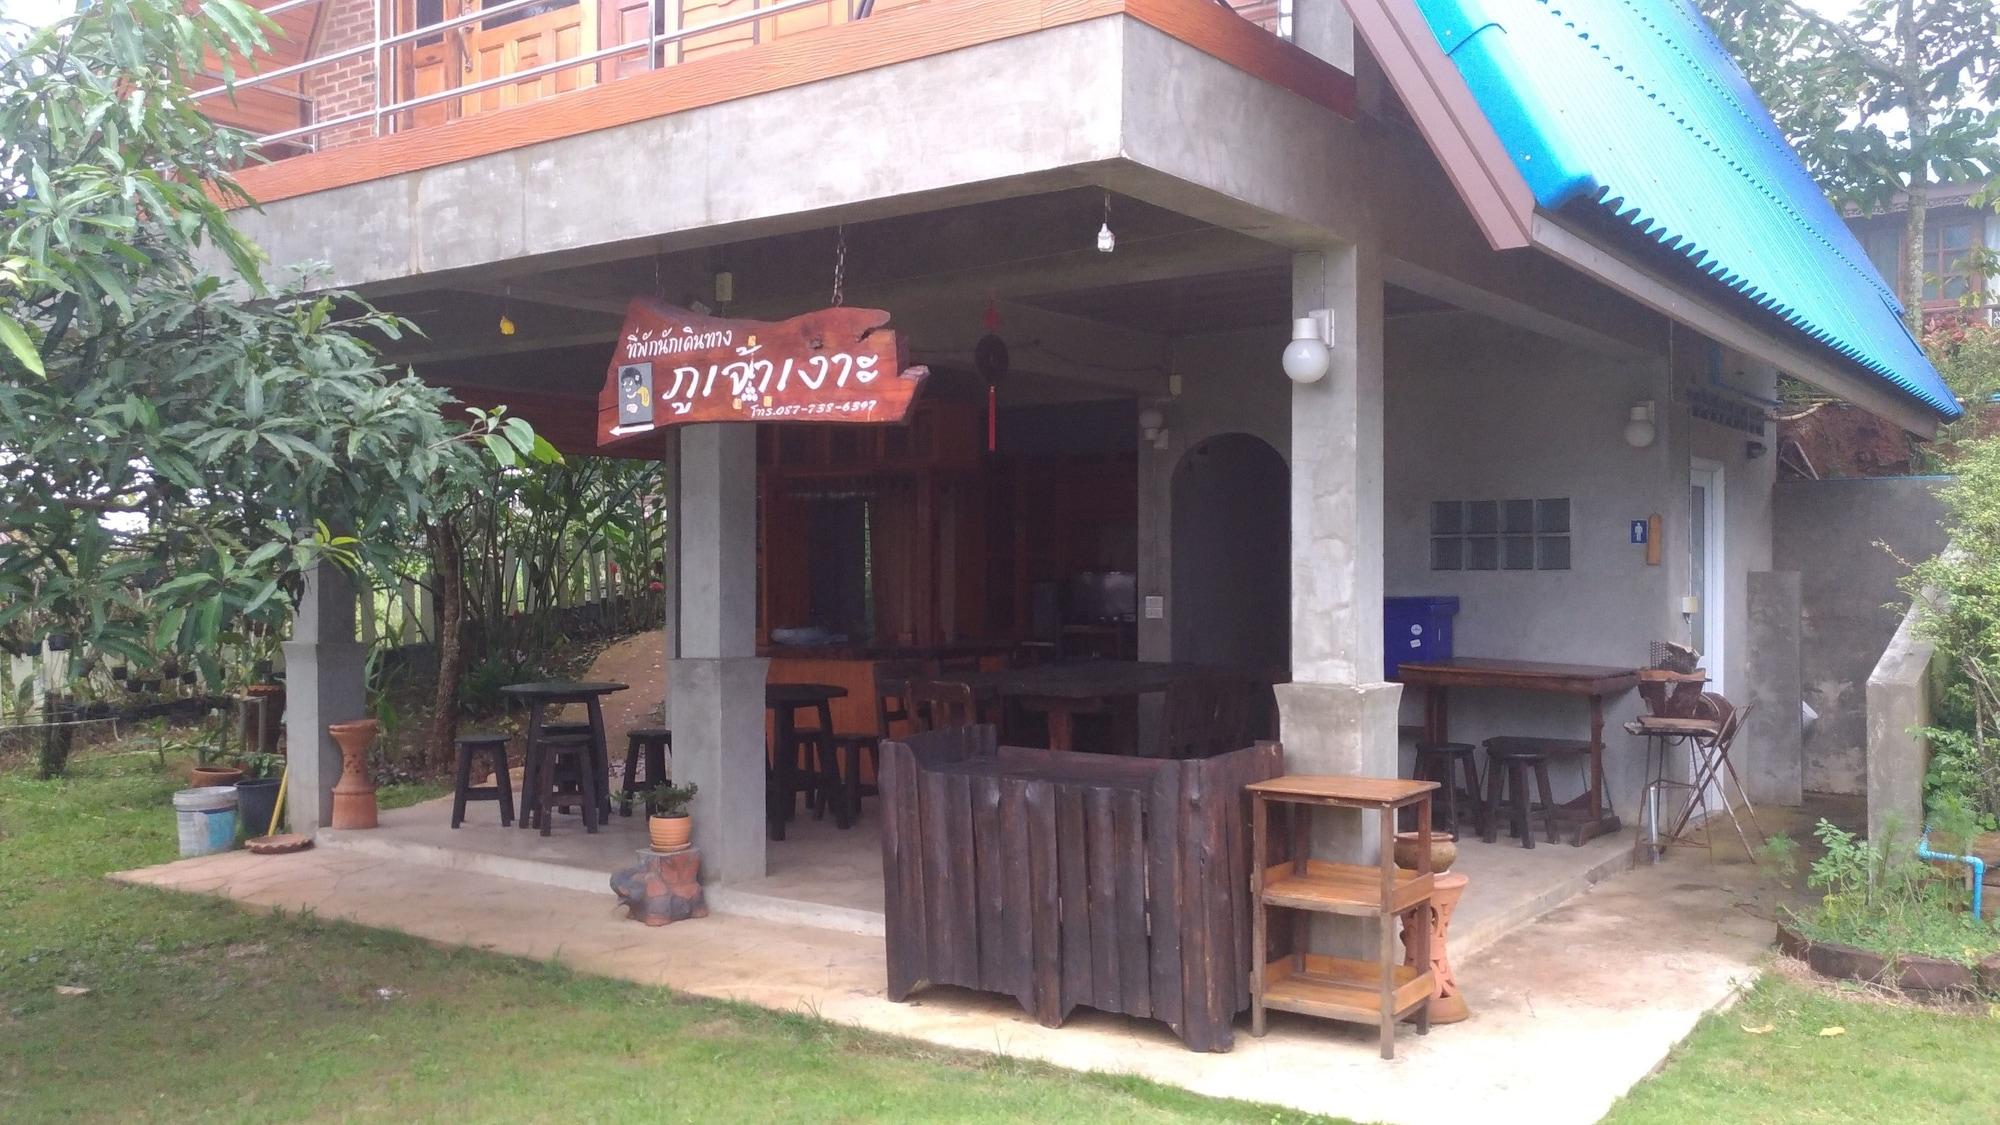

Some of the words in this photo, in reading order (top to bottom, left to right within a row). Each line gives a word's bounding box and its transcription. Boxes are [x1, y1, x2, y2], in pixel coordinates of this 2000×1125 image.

[626, 326, 732, 359] ที่พักนักเดินทาง
